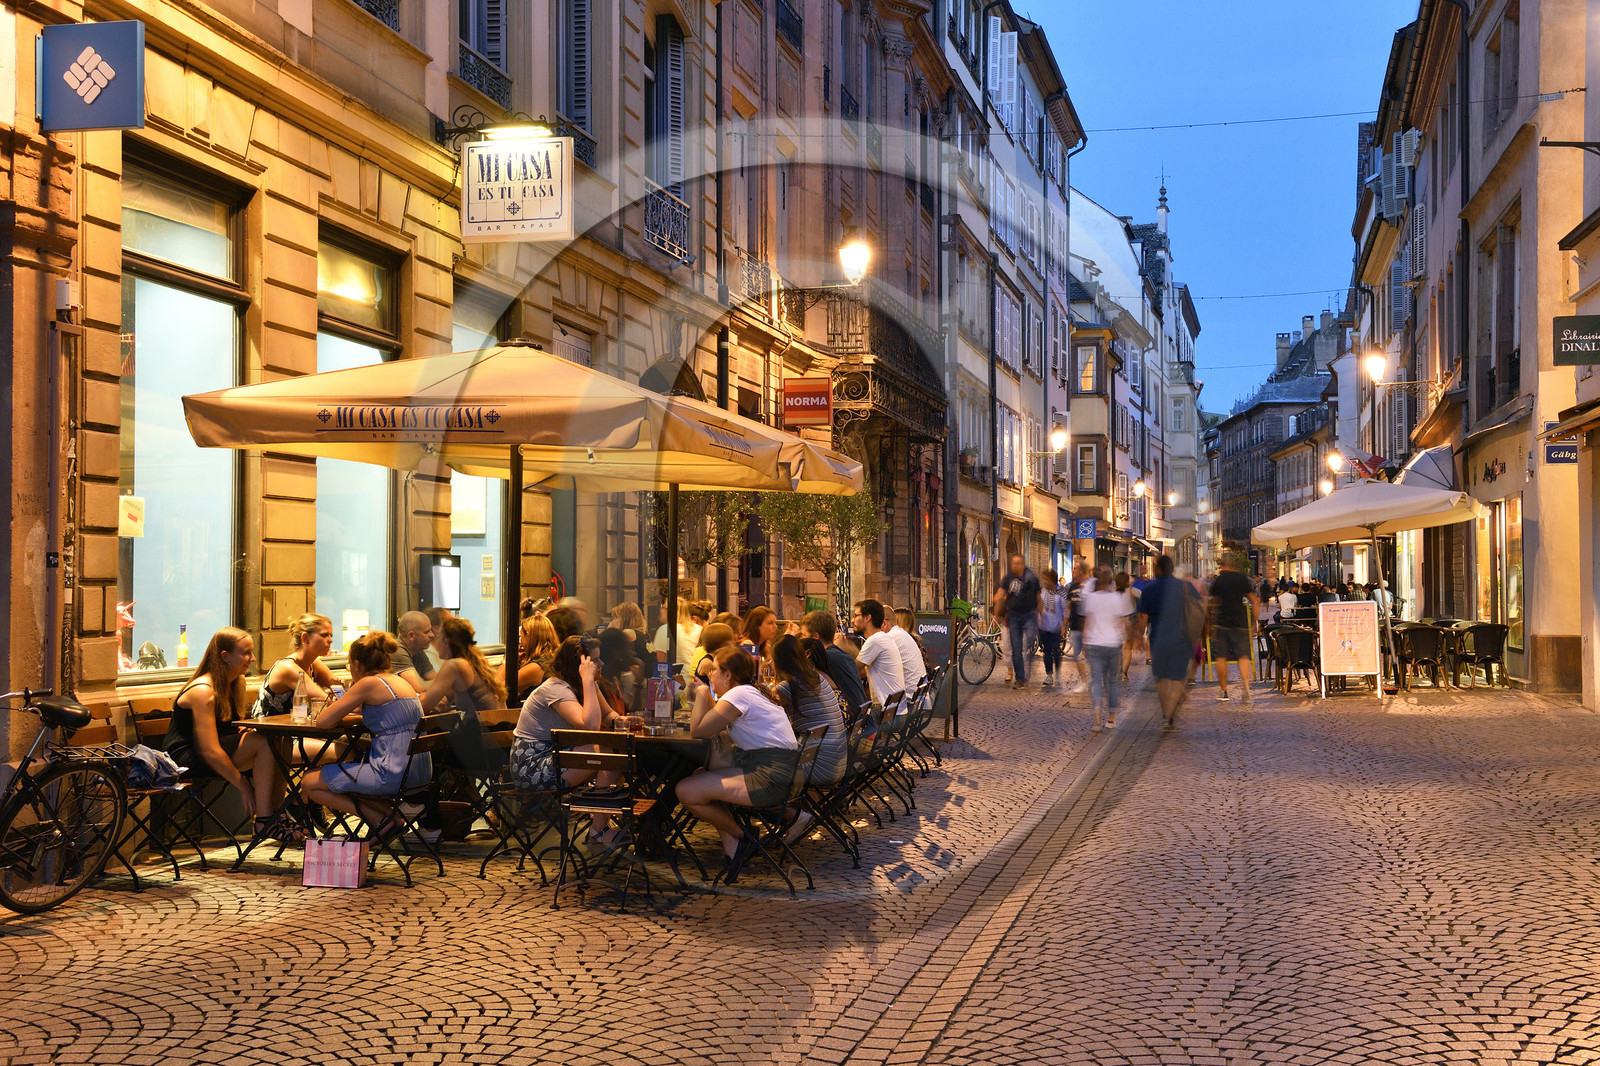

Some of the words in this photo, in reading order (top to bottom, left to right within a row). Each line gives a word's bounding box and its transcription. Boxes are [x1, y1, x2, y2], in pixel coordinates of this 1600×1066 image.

[477, 153, 500, 183] MI
[507, 150, 553, 182] CASA
[478, 187, 494, 200] ES
[498, 186, 515, 200] TU
[523, 184, 554, 198] CASA
[785, 396, 828, 406] NORMA
[335, 406, 356, 428] MI
[359, 407, 397, 428] CASA
[402, 407, 419, 428] ES
[424, 407, 443, 428] TU
[445, 407, 484, 428] CASA
[918, 623, 948, 635] ORANGINA
